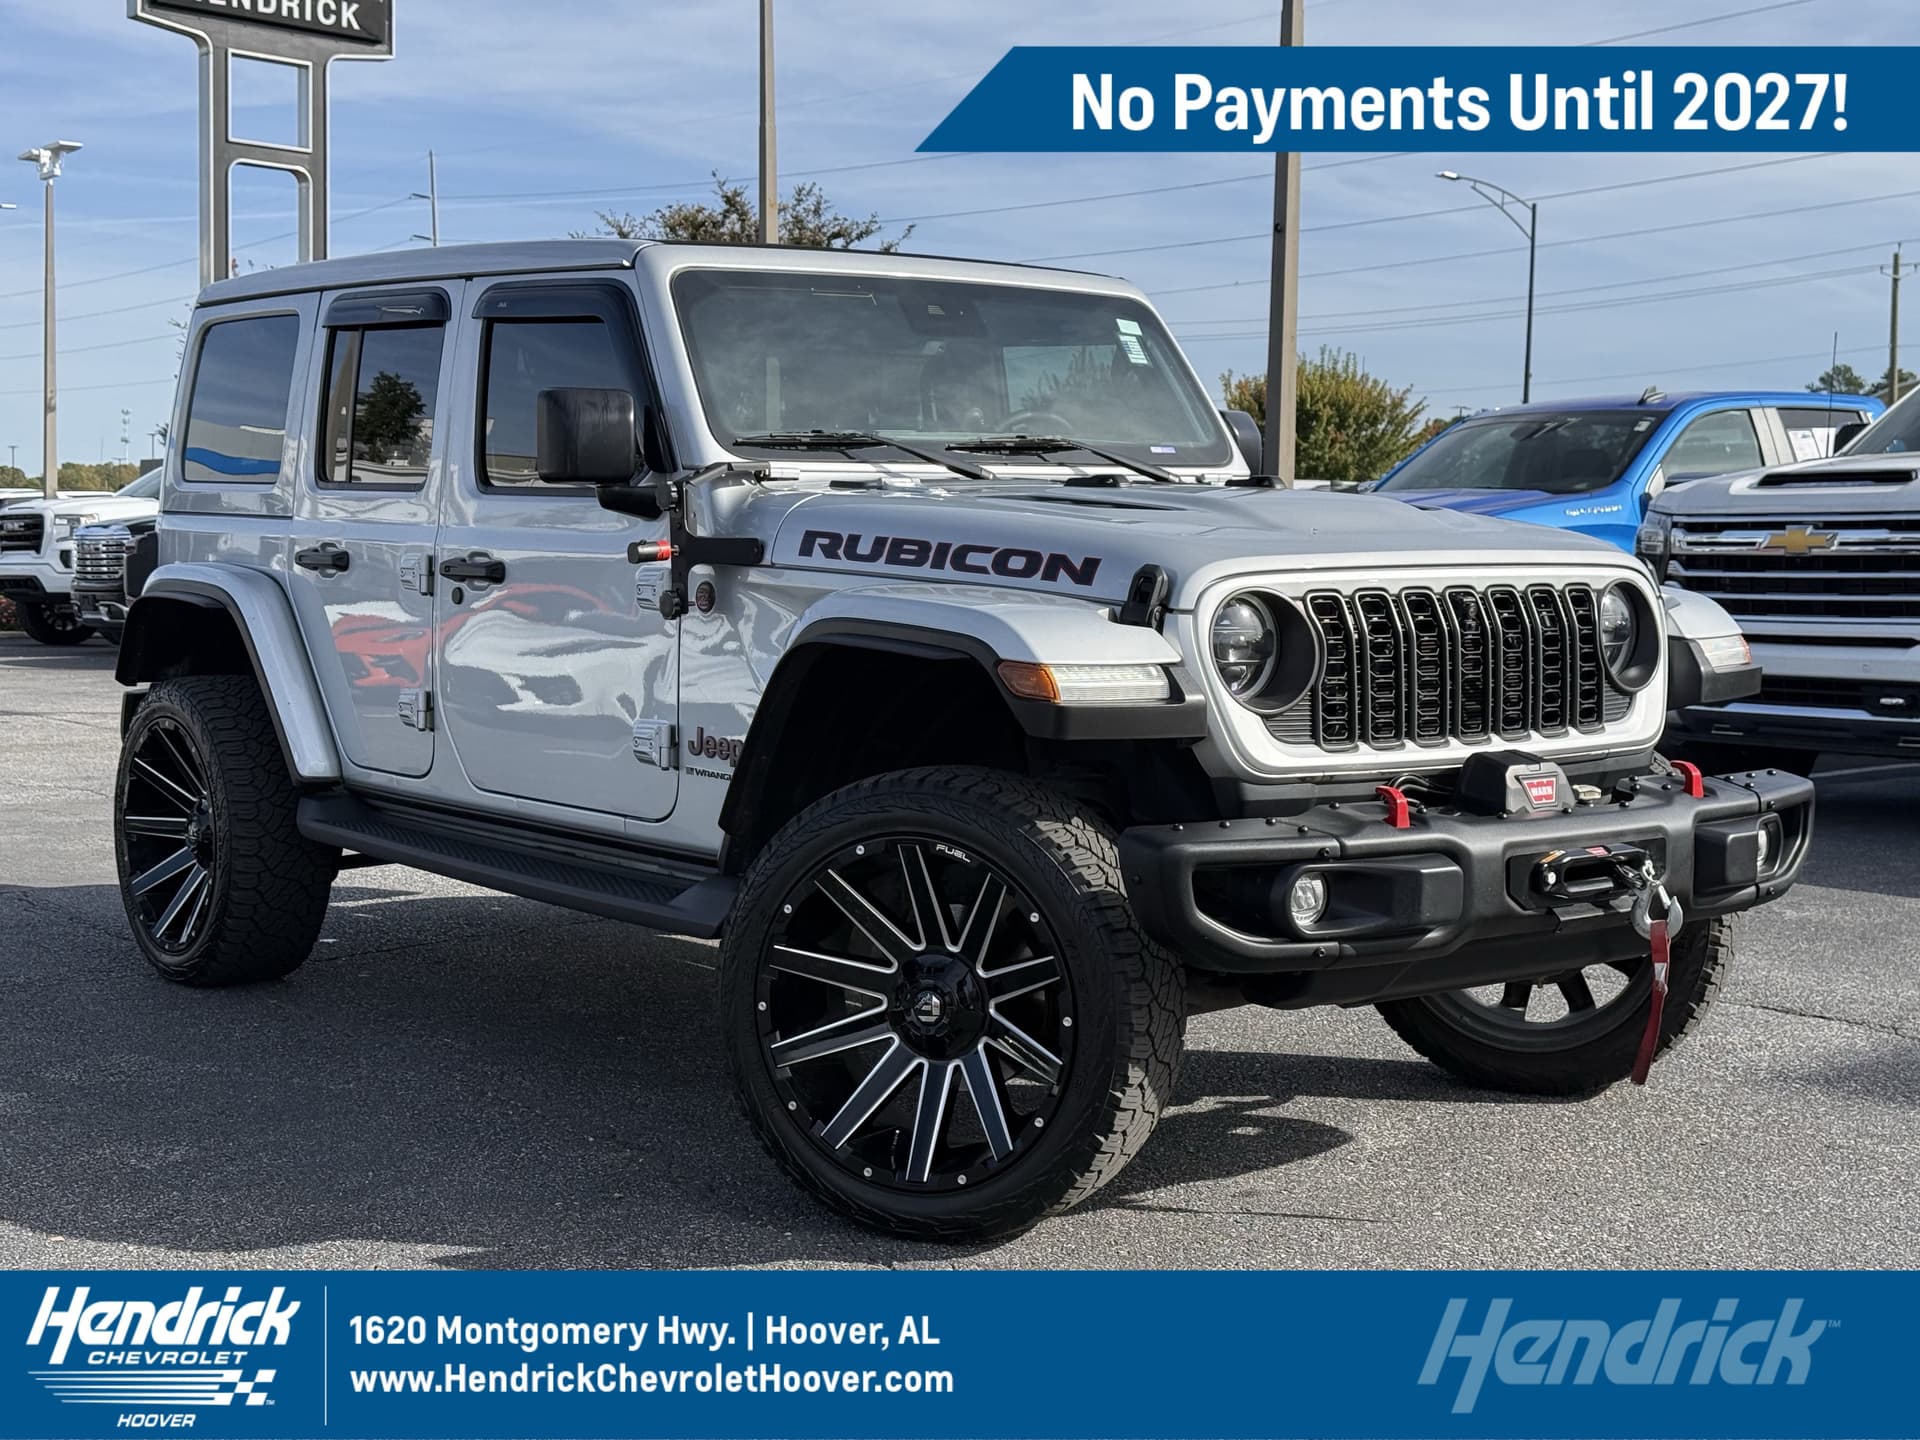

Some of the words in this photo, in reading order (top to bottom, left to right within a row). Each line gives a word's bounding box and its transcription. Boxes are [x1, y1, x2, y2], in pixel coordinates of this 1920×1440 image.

[798, 530, 1103, 587] RUBICON
[688, 726, 744, 768] Jeep
[936, 844, 971, 862] FUEL
